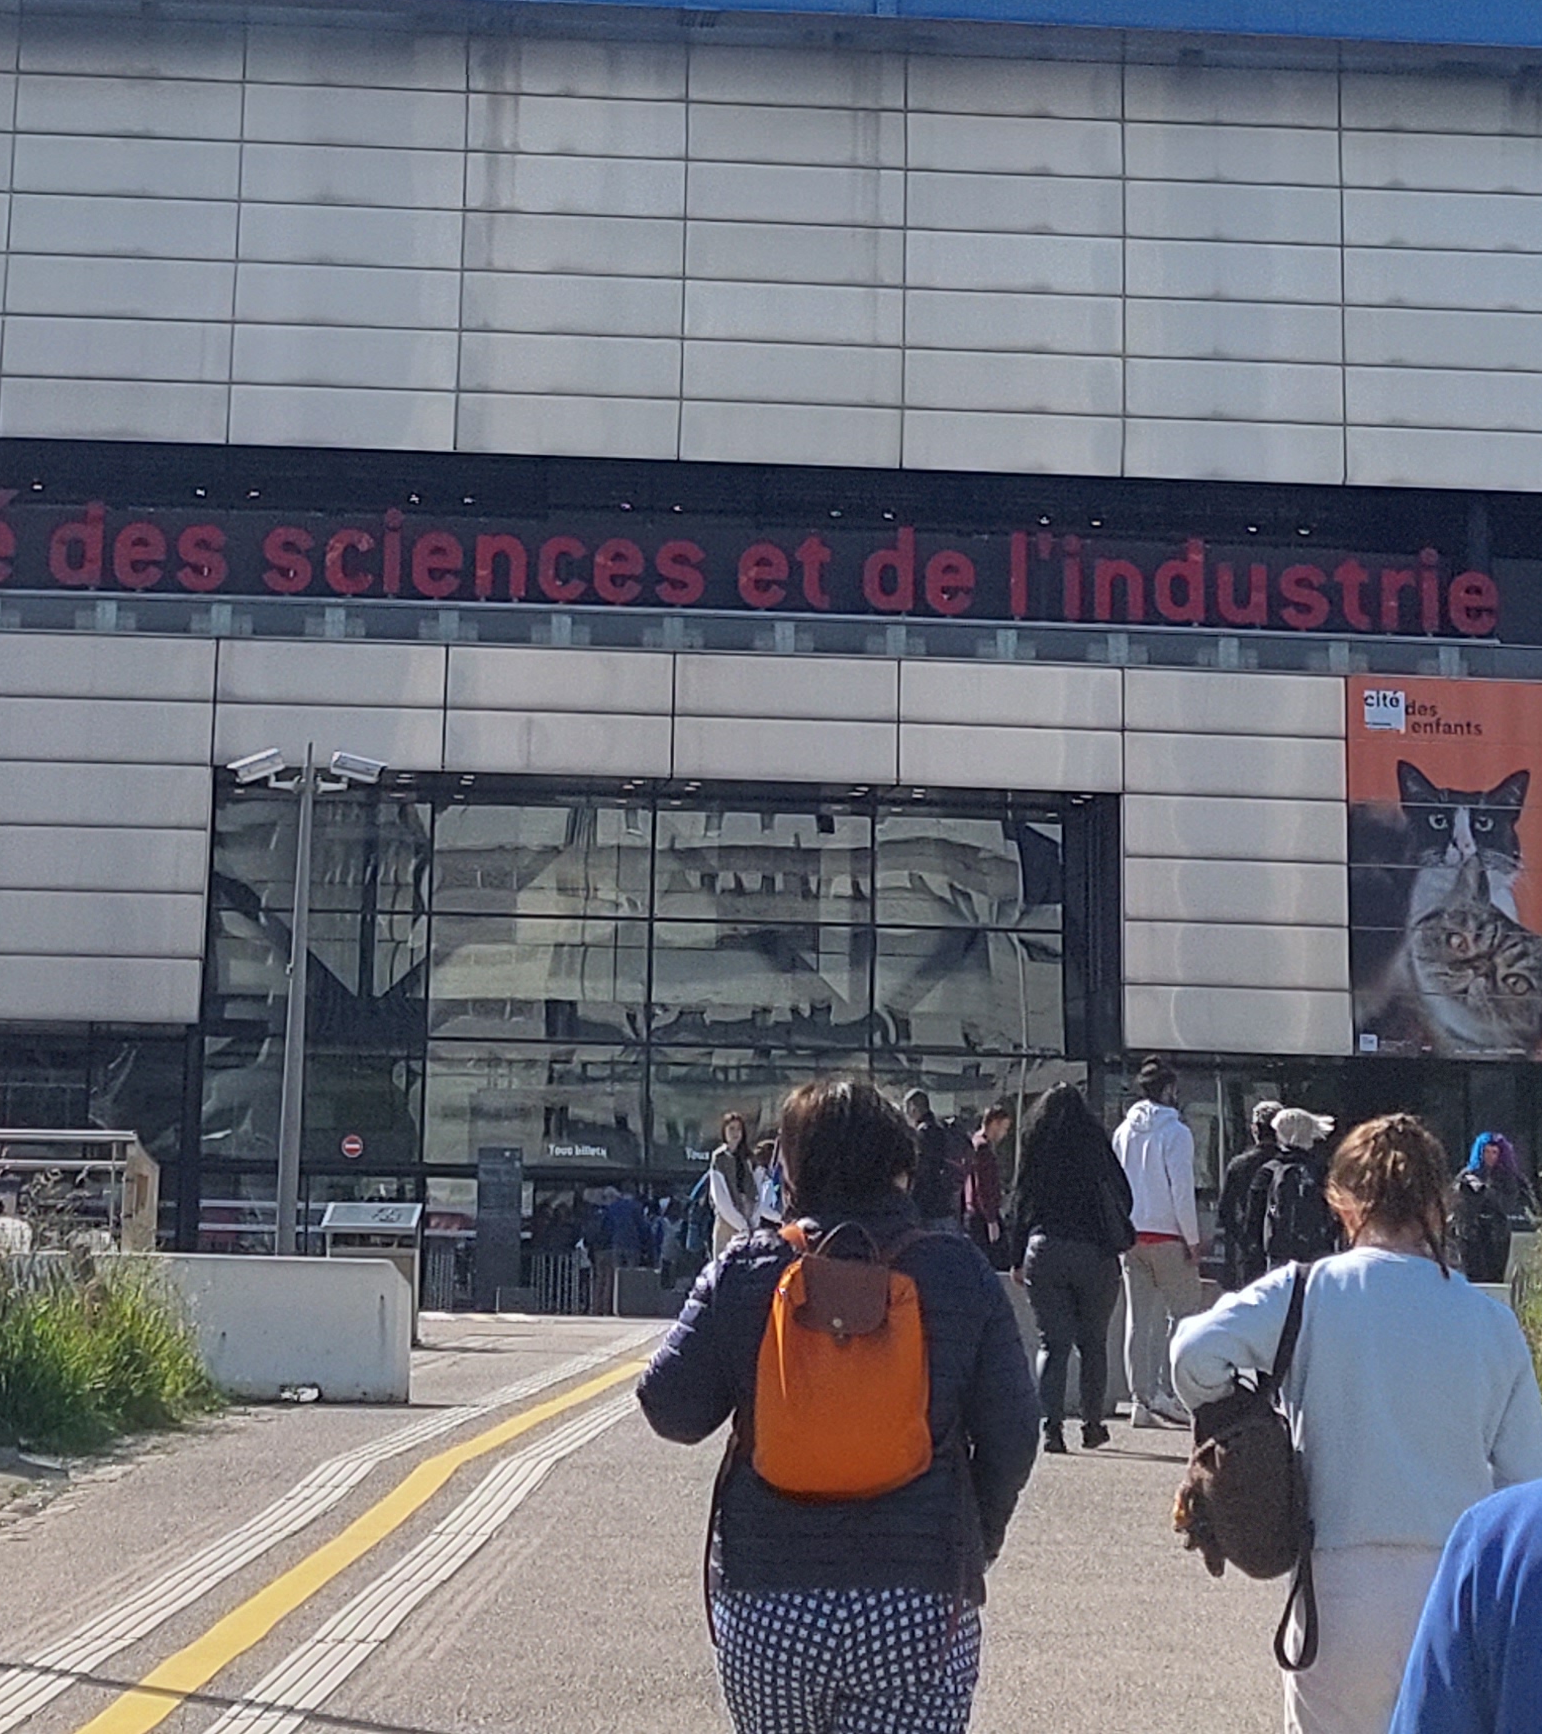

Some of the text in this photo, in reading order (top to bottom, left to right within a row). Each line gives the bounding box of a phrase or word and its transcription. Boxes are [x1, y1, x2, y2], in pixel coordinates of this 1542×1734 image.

[49, 501, 227, 592] des
[263, 508, 706, 605] sciences
[738, 530, 832, 609] et
[863, 526, 975, 615] de
[1010, 531, 1501, 635] l'industrie
[1364, 691, 1437, 716] cité des
[1411, 718, 1483, 736] enfants
